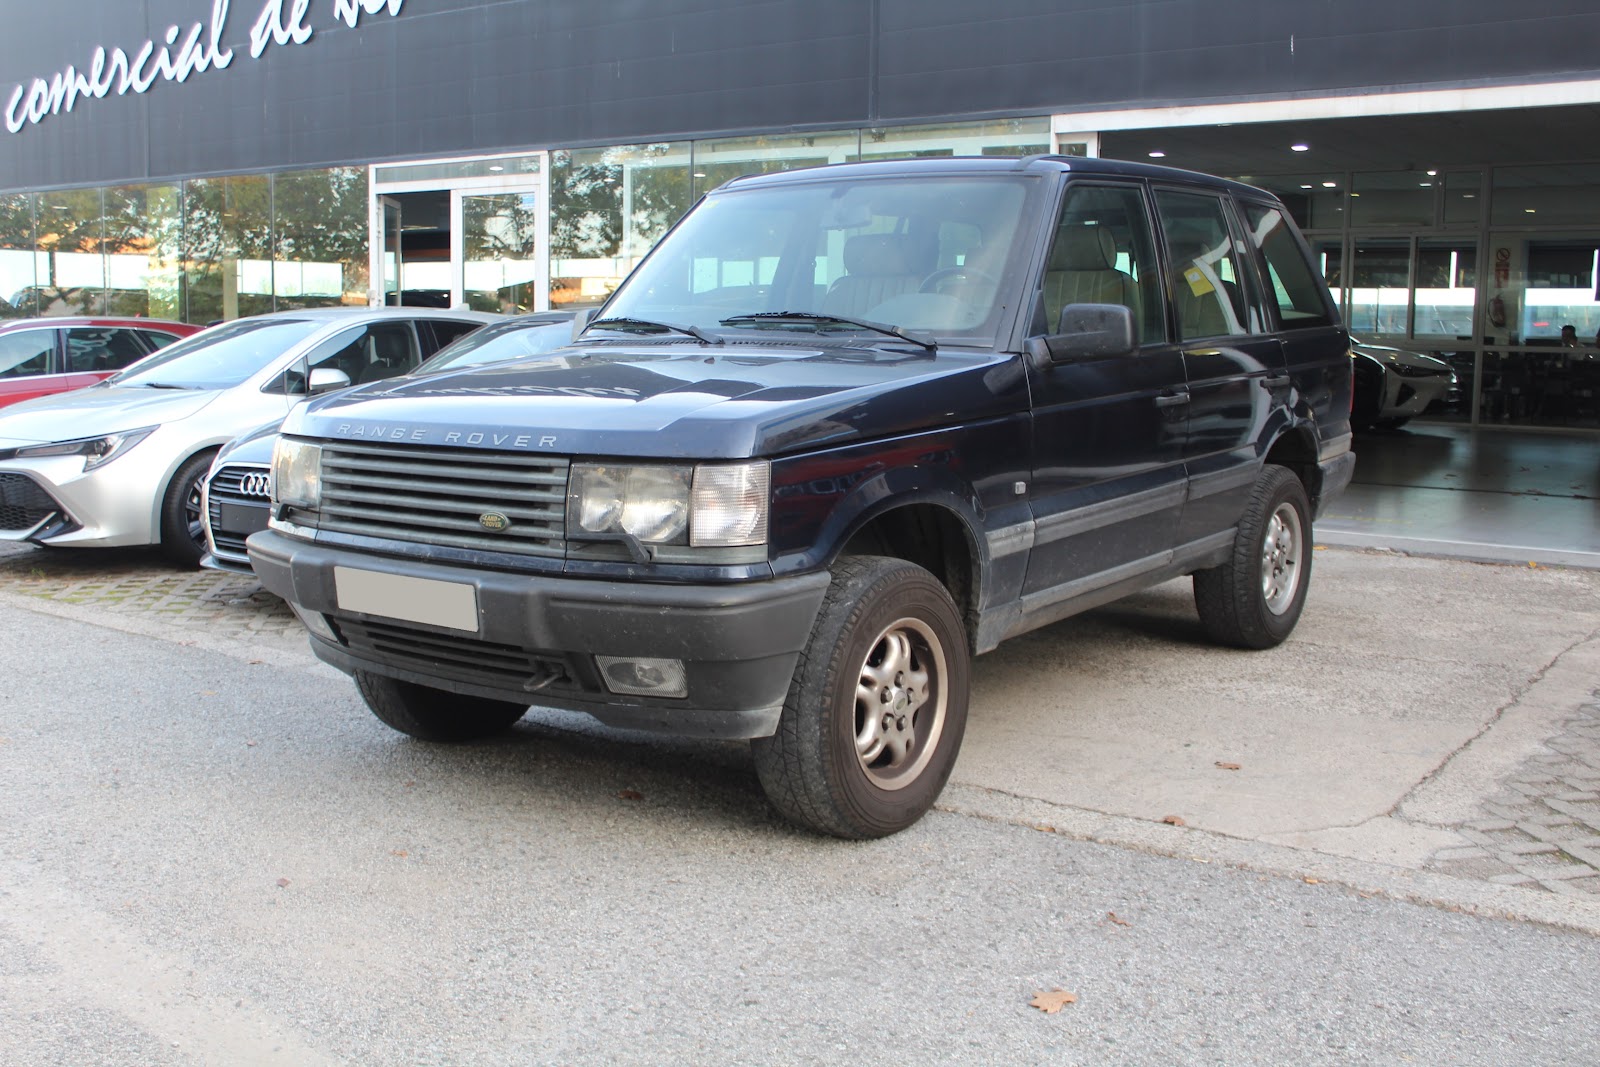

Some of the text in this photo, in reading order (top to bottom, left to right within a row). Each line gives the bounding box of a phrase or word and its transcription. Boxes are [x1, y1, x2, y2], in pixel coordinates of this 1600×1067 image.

[5, 0, 313, 134] comercial de
[336, 423, 557, 448] RANGE ROVER
